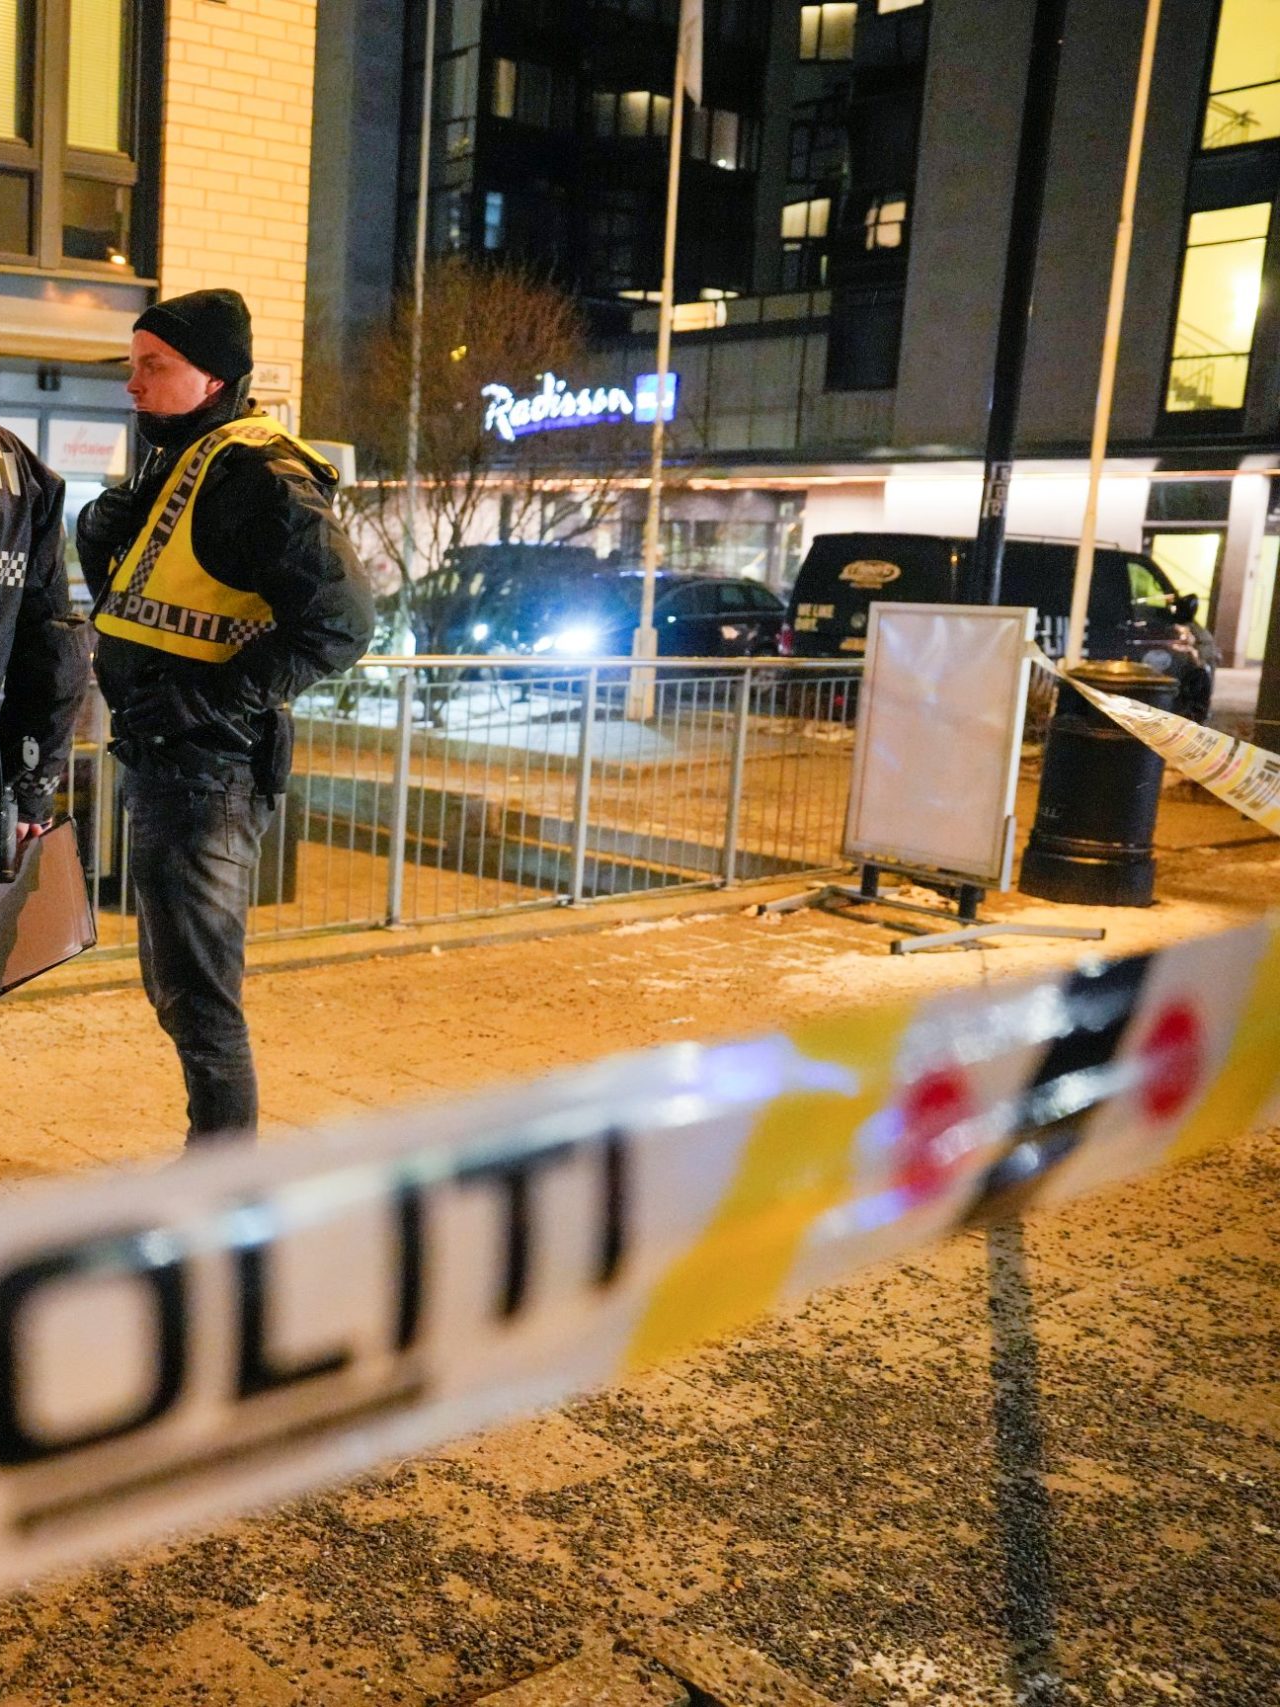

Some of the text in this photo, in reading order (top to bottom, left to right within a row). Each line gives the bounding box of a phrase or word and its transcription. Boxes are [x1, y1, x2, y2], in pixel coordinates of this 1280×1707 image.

[481, 372, 634, 442] Radisson
[157, 432, 224, 535] POLITI
[123, 594, 220, 641] POLITI
